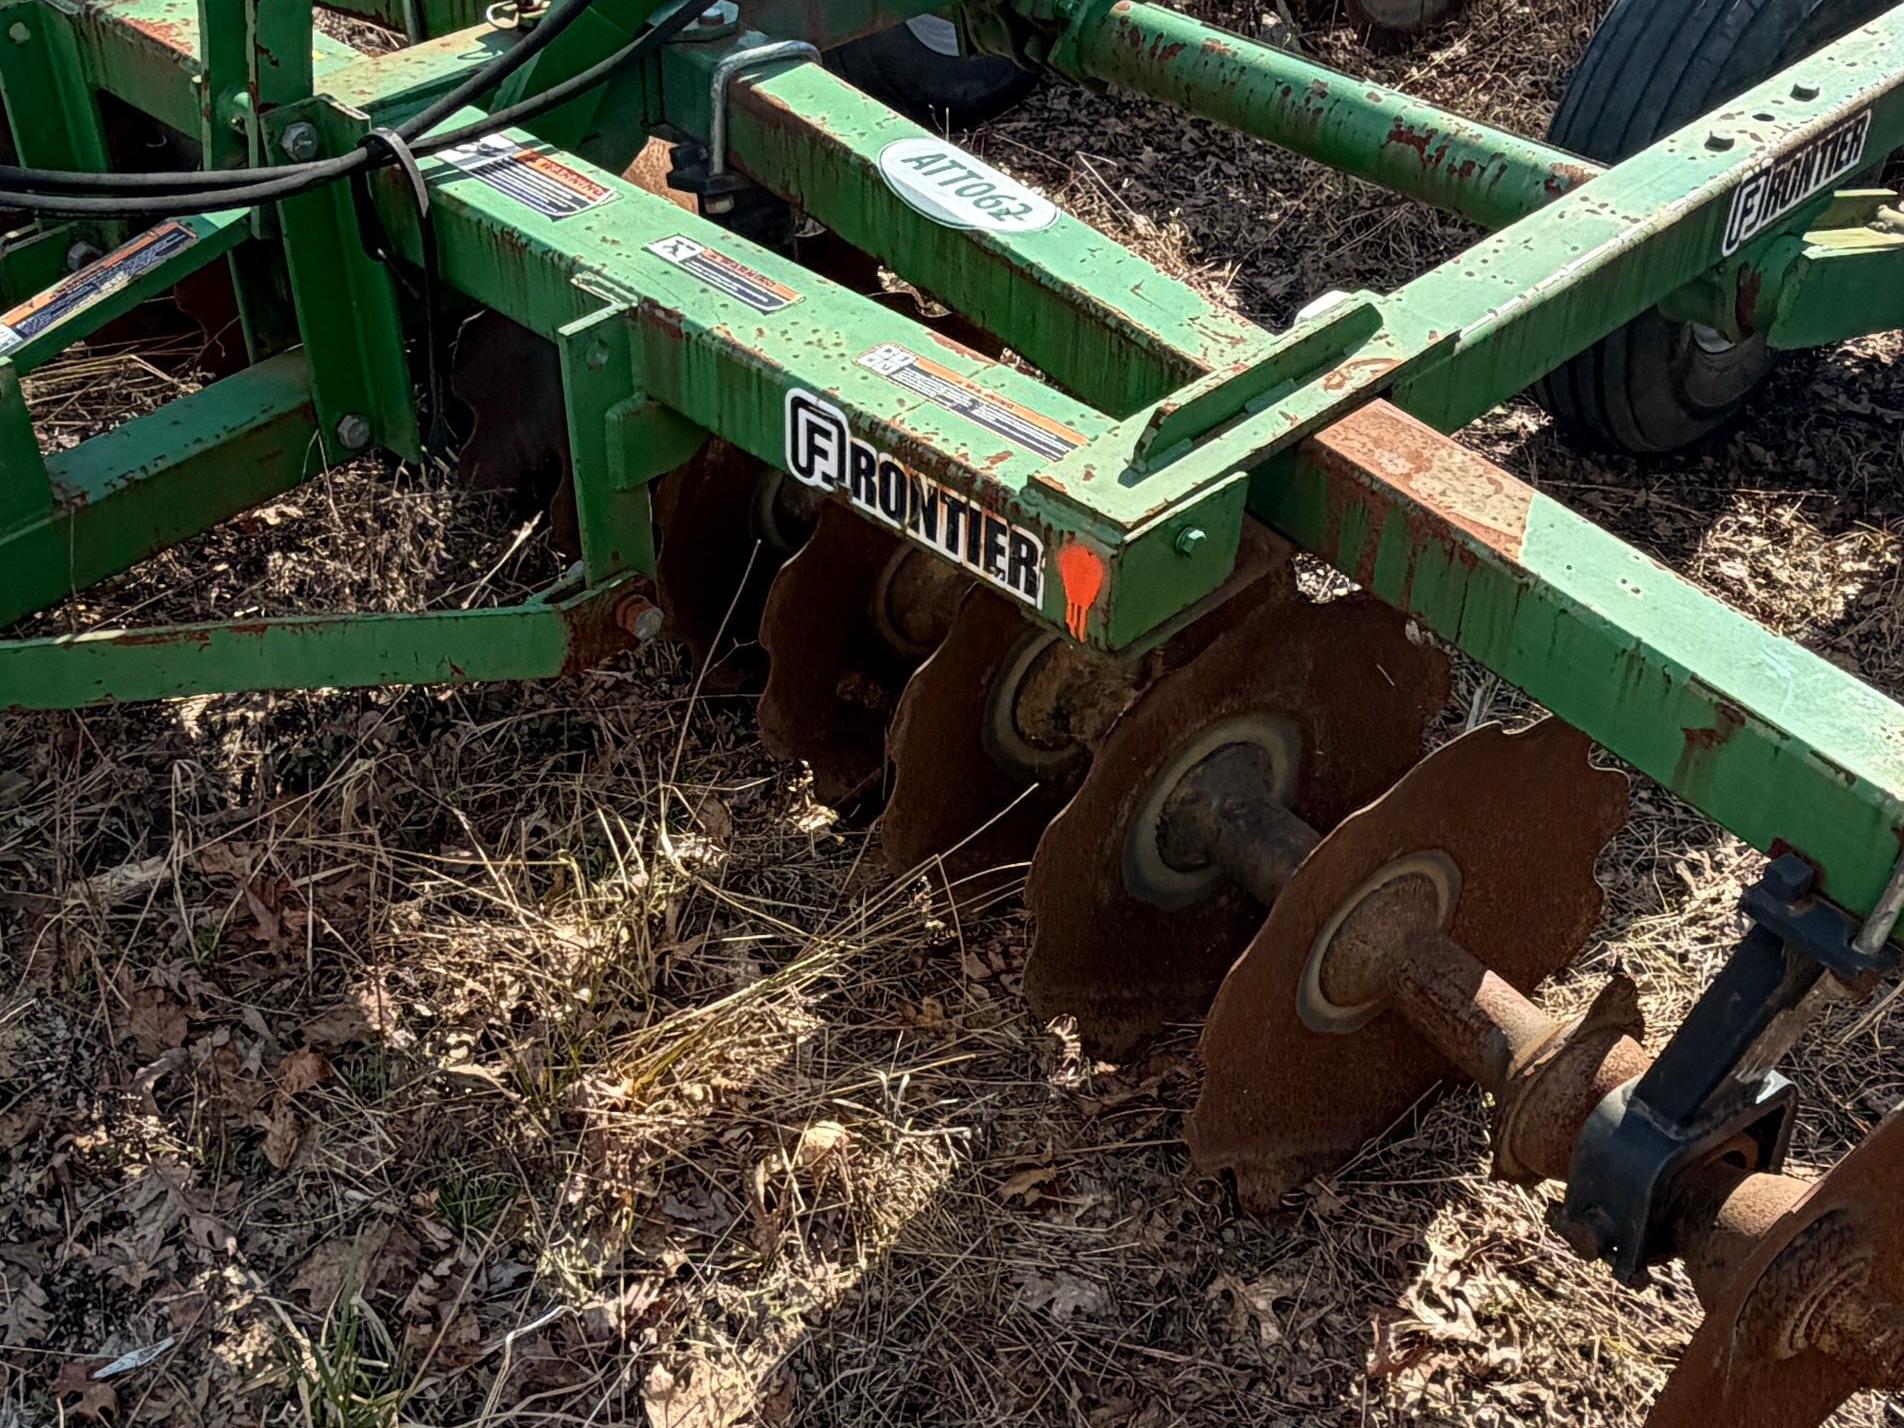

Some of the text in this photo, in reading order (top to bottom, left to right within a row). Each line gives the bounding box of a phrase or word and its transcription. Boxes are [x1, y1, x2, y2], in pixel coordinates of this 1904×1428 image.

[900, 152, 1034, 222] ATT062
[1721, 109, 1871, 257] FRONTIER
[786, 388, 1045, 609] FRONTIER
